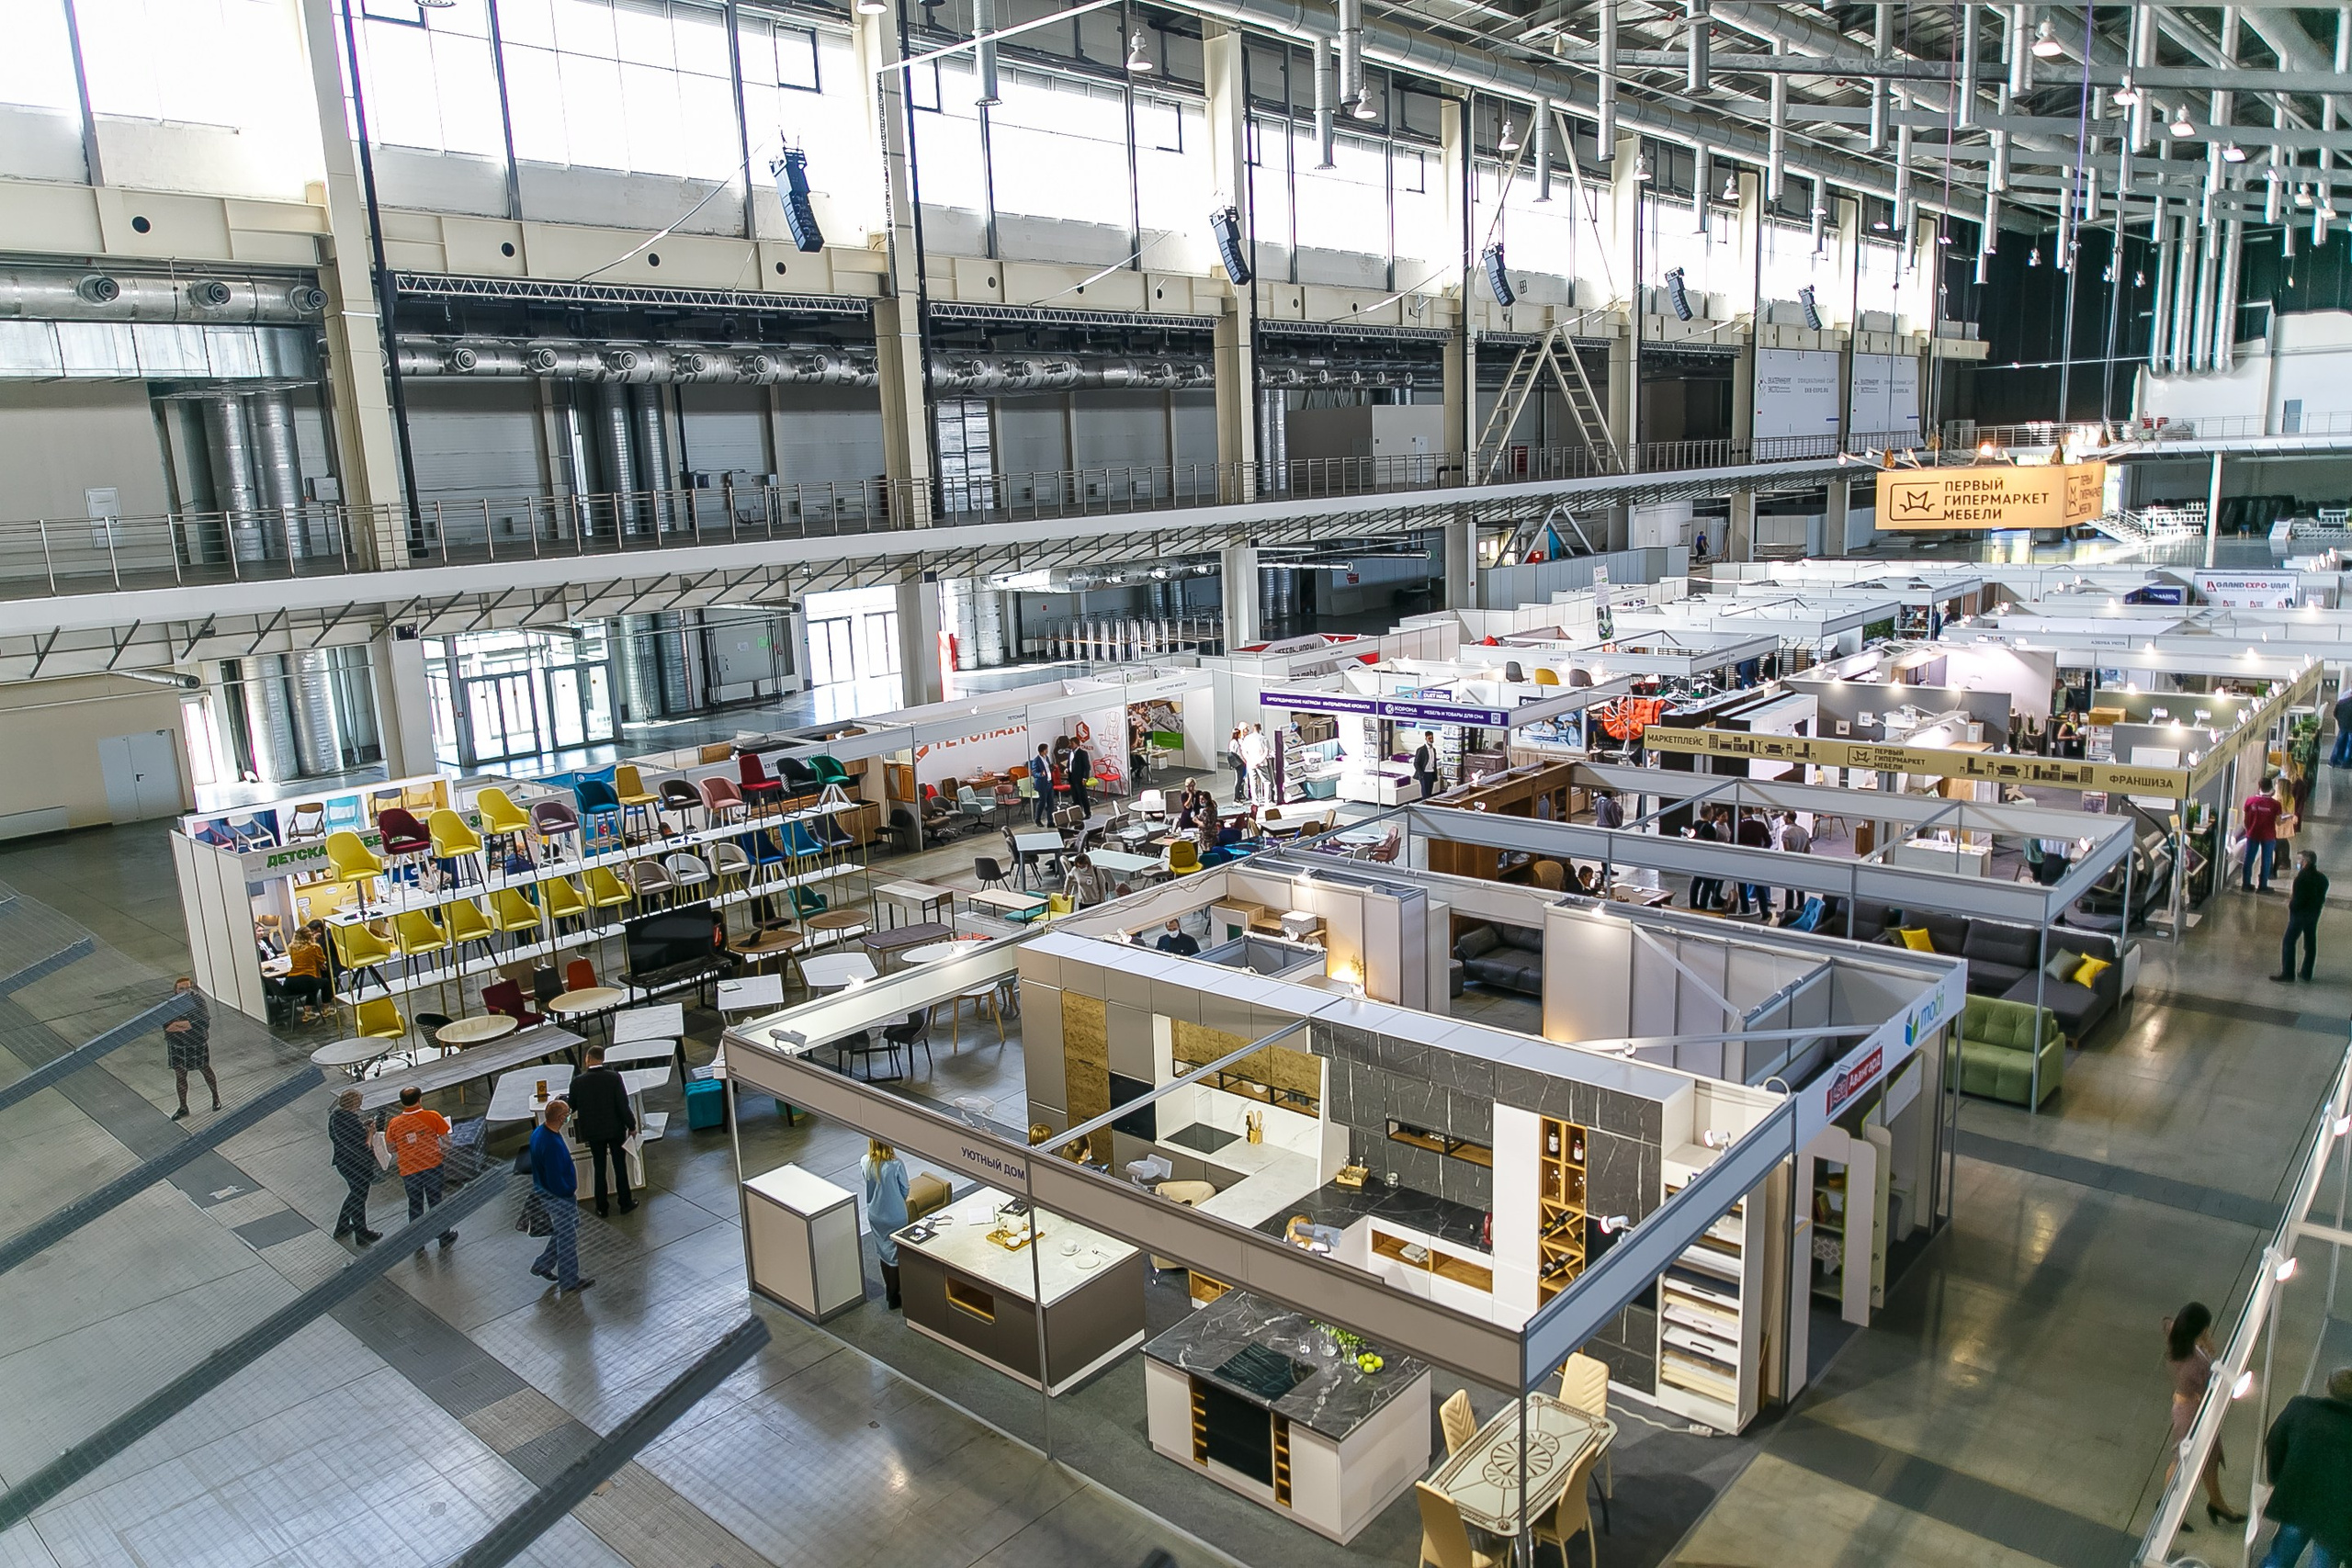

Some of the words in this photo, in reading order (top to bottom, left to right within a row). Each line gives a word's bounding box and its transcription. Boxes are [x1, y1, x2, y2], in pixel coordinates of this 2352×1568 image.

[1945, 477, 2004, 492] ПЕРВЫЙ
[1944, 492, 2050, 506] ГИПЕРМАРКЕТ
[1944, 508, 2002, 521] МЕБЕЛИ
[1647, 734, 1703, 747] МАРКЕТПЛЕЙС
[1874, 747, 1905, 756] ПЕРВЫЙ
[1874, 755, 1926, 766] ГИПЕРМАРКЕТ
[1874, 761, 1904, 771] МЕБЕЛИ
[2109, 774, 2174, 789] ФРАНШИЗА
[266, 844, 327, 869] ДЕТСКА
[1849, 1053, 1882, 1090] Авангард
[961, 1146, 1002, 1172] УЮТНЫЙ
[1003, 1163, 1025, 1180] ДОМ
